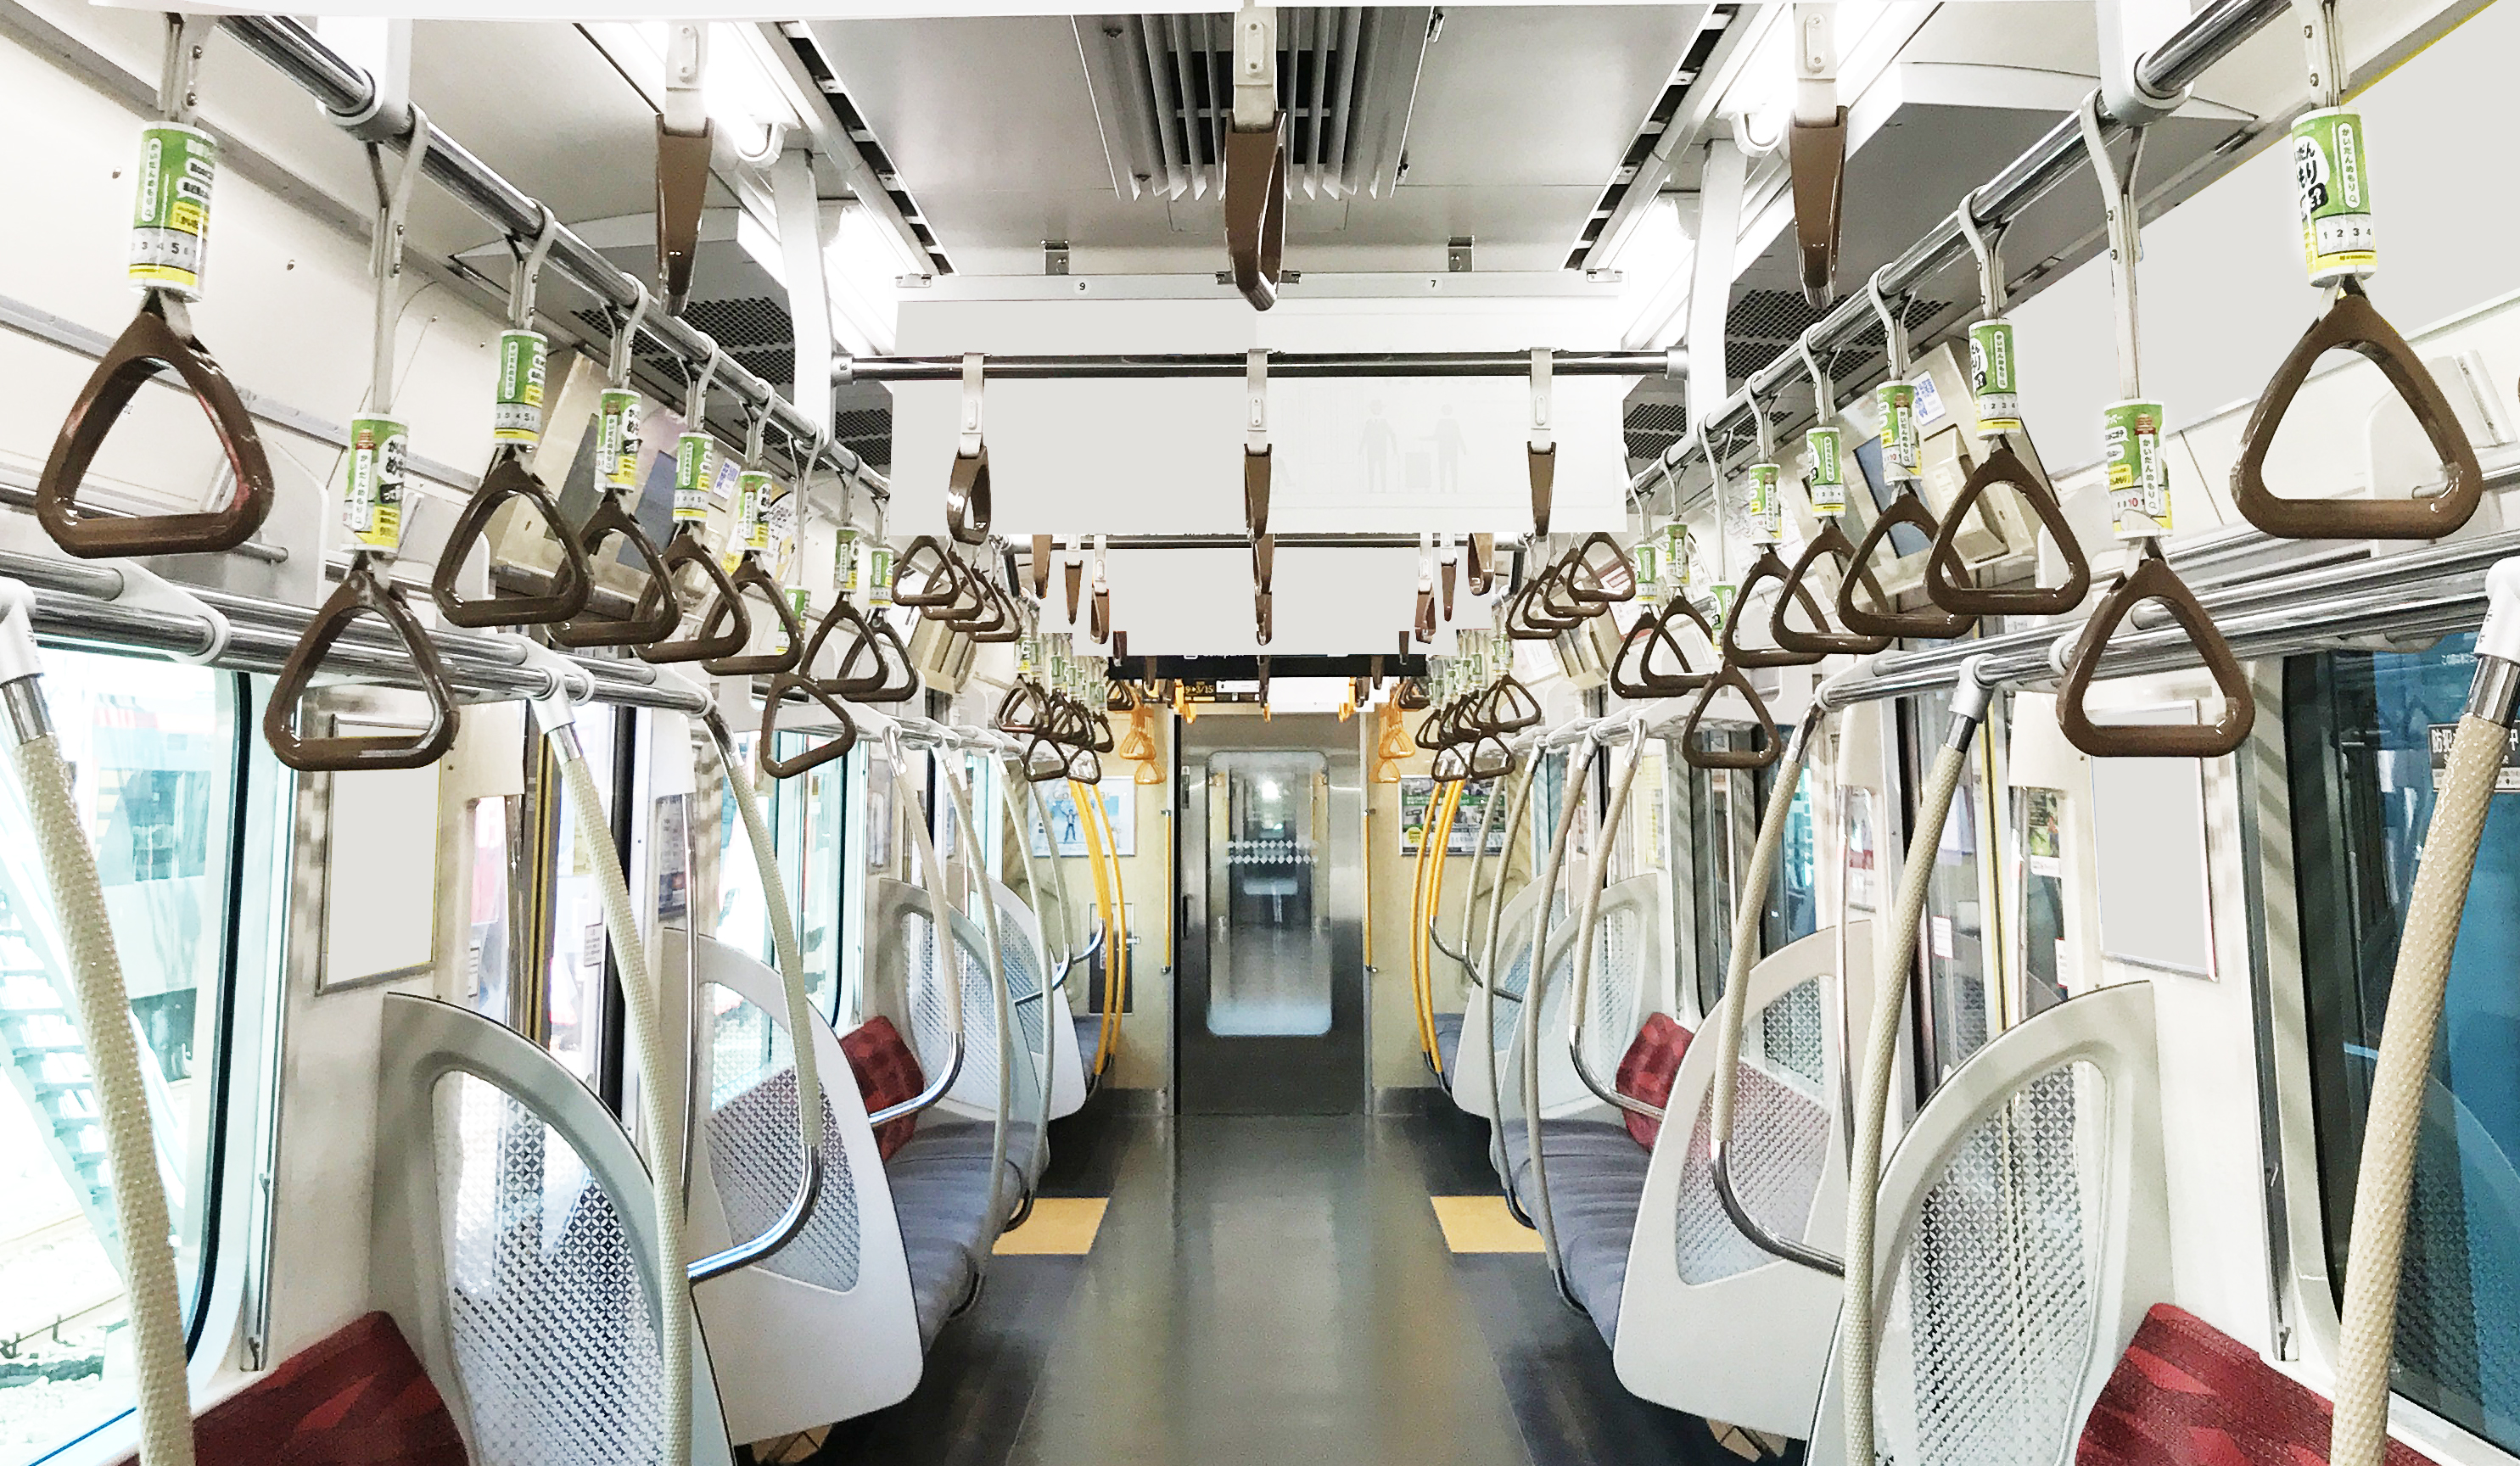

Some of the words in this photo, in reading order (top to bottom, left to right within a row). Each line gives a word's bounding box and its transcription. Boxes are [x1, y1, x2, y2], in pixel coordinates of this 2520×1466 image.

[2342, 128, 2355, 192] かいだんめもり
[2337, 228, 2344, 238] 2
[2353, 227, 2360, 237] 3
[142, 241, 148, 249] 3
[171, 242, 180, 254] 5
[1079, 282, 1085, 290] 9
[1431, 279, 1436, 288] 7
